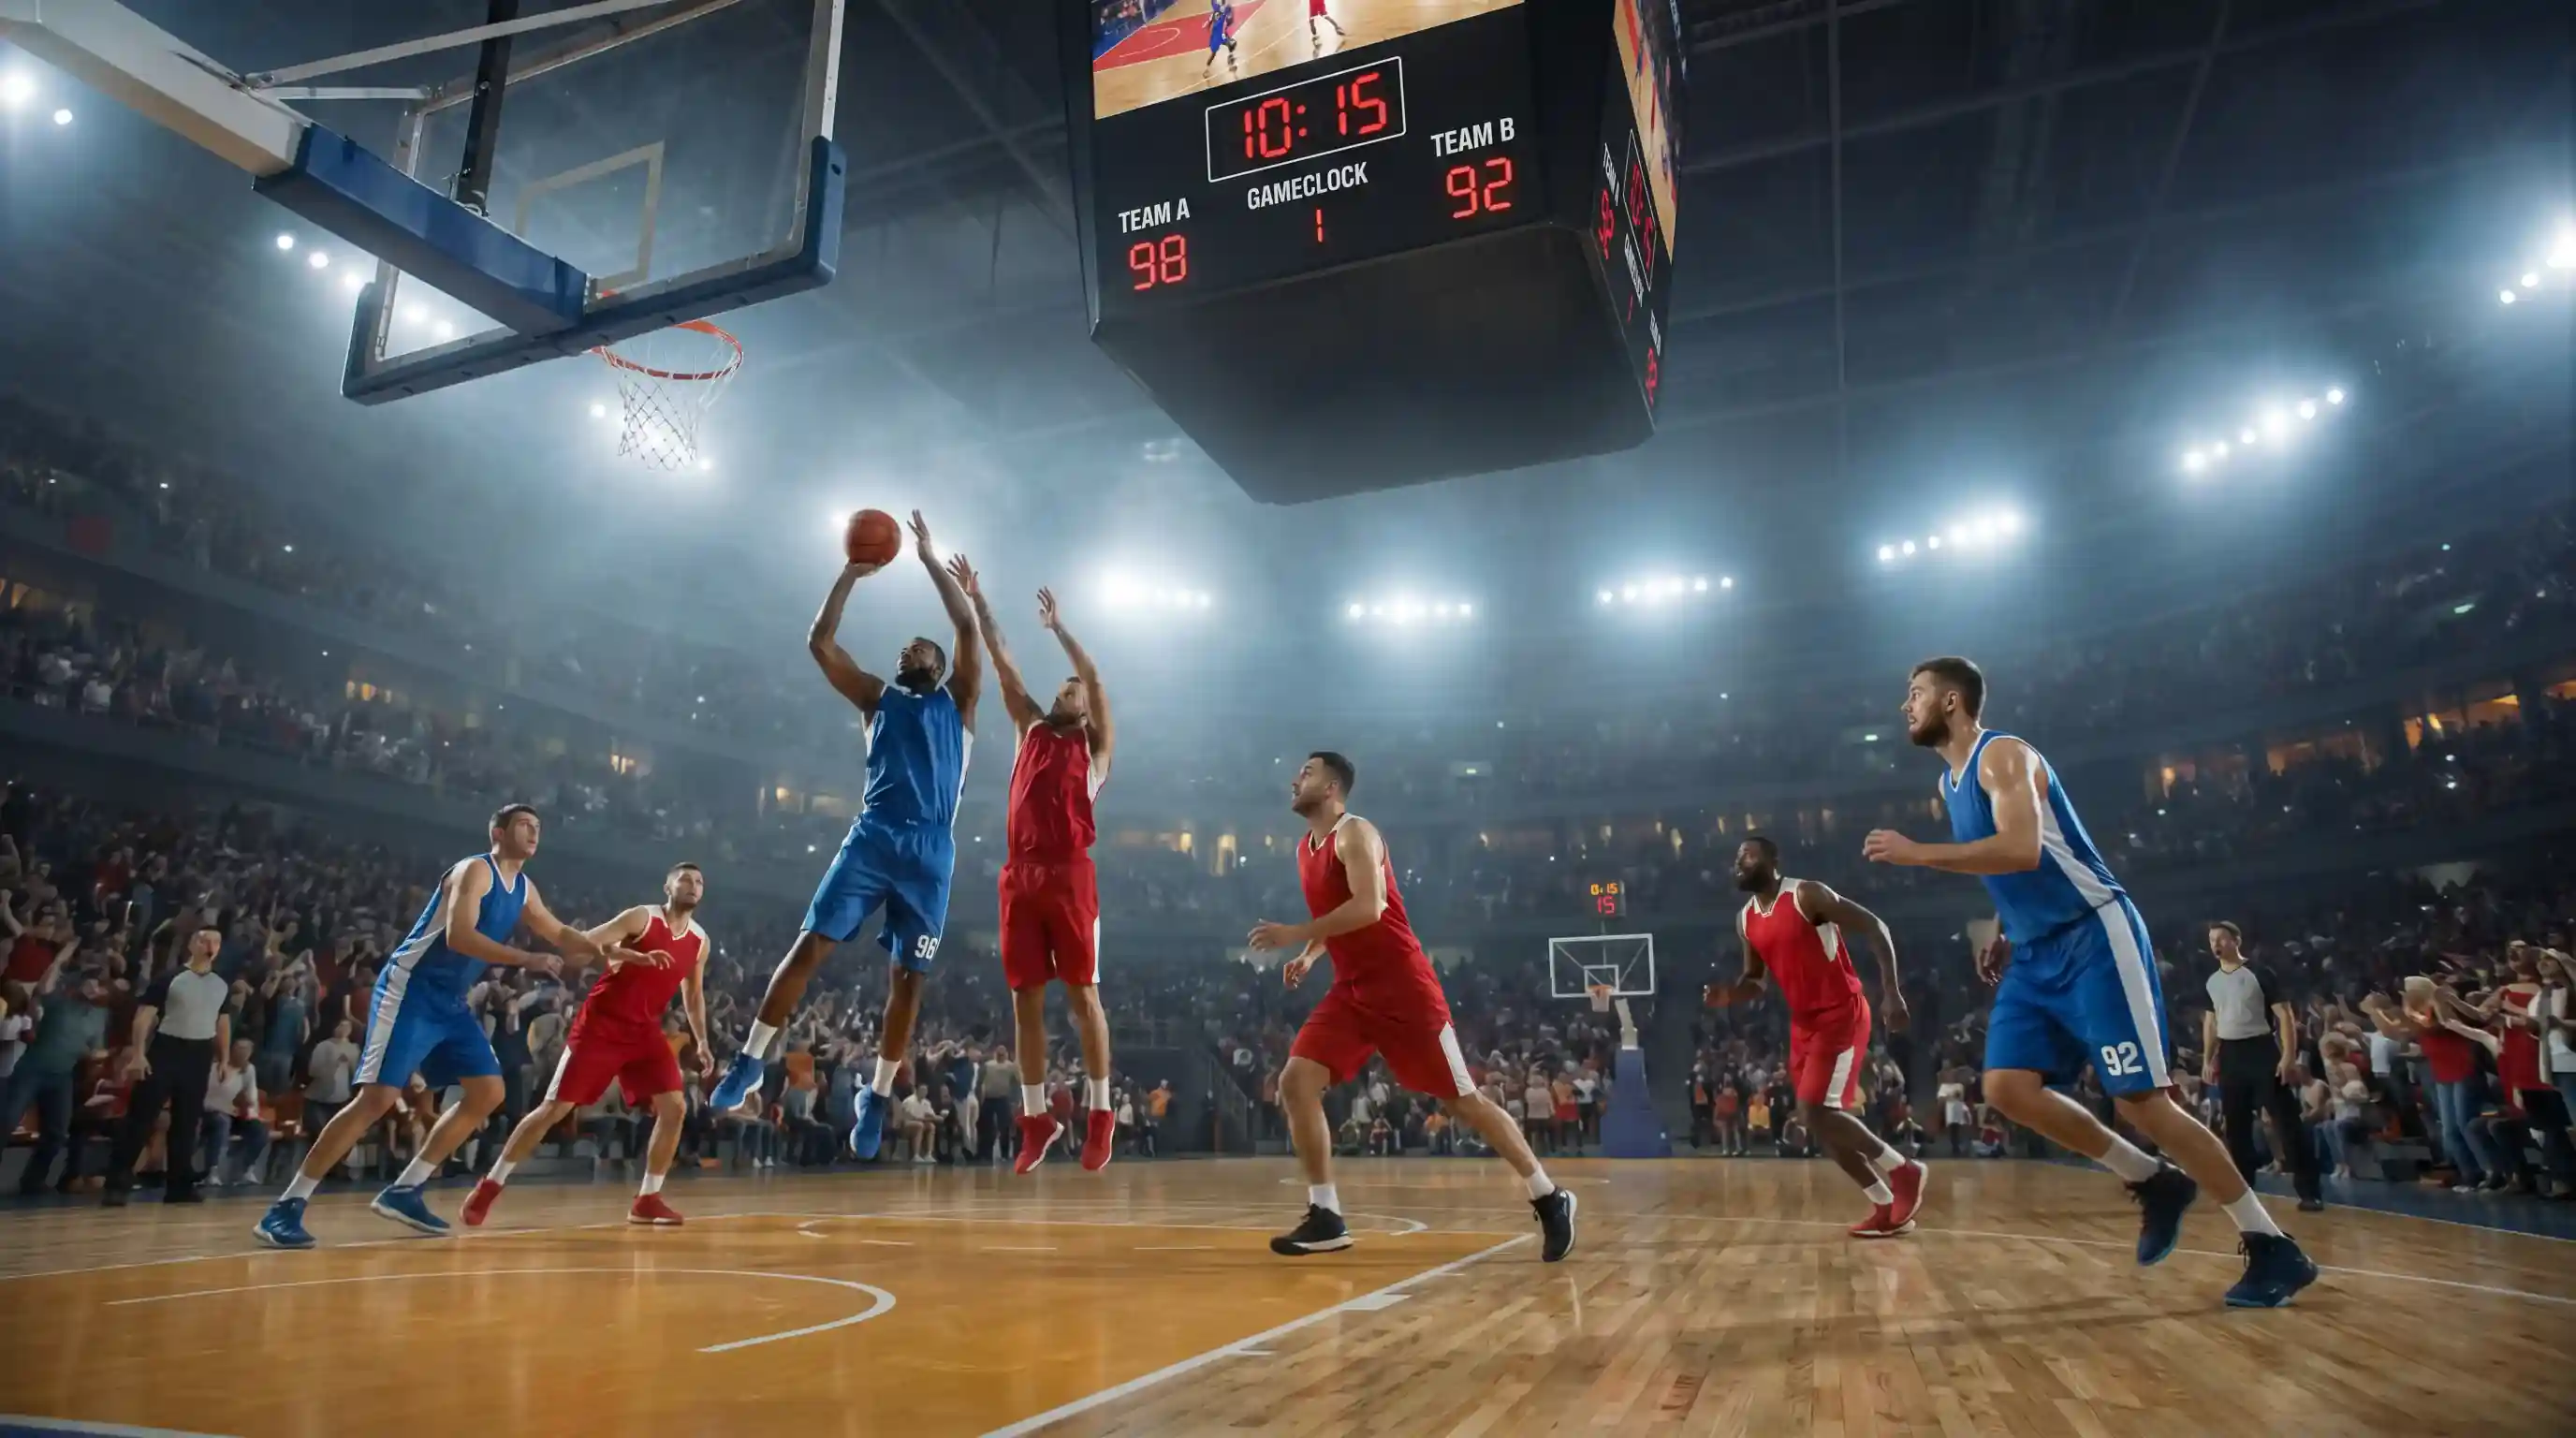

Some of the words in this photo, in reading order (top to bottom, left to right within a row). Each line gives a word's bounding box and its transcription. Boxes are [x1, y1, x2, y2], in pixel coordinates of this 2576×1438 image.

[1430, 121, 1493, 157] TEAM
[1500, 117, 1515, 141] B
[1247, 162, 1368, 210] GAMECLOCK
[1446, 157, 1513, 219] 92
[1118, 201, 1171, 233] TEAM
[1177, 198, 1191, 220] A
[1316, 209, 1324, 242] 1
[1129, 234, 1188, 290] 98
[1597, 895, 1615, 915] 15
[2100, 1041, 2143, 1076] 92
